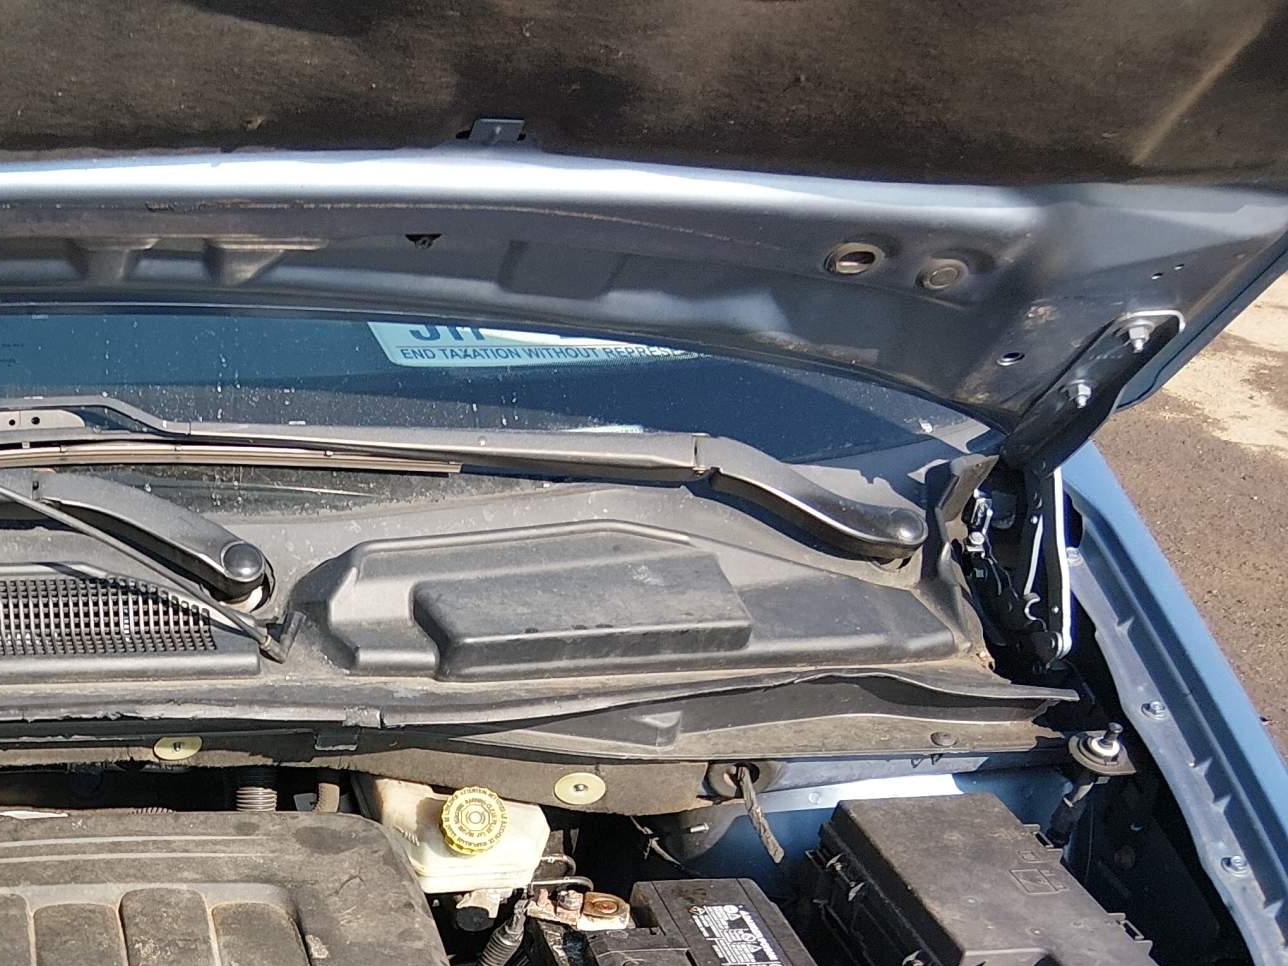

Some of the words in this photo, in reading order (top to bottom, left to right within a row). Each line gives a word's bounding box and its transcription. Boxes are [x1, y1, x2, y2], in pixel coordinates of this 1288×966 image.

[401, 348, 436, 360] END
[441, 348, 521, 360] TAXATION
[525, 346, 601, 359] WITHOUT
